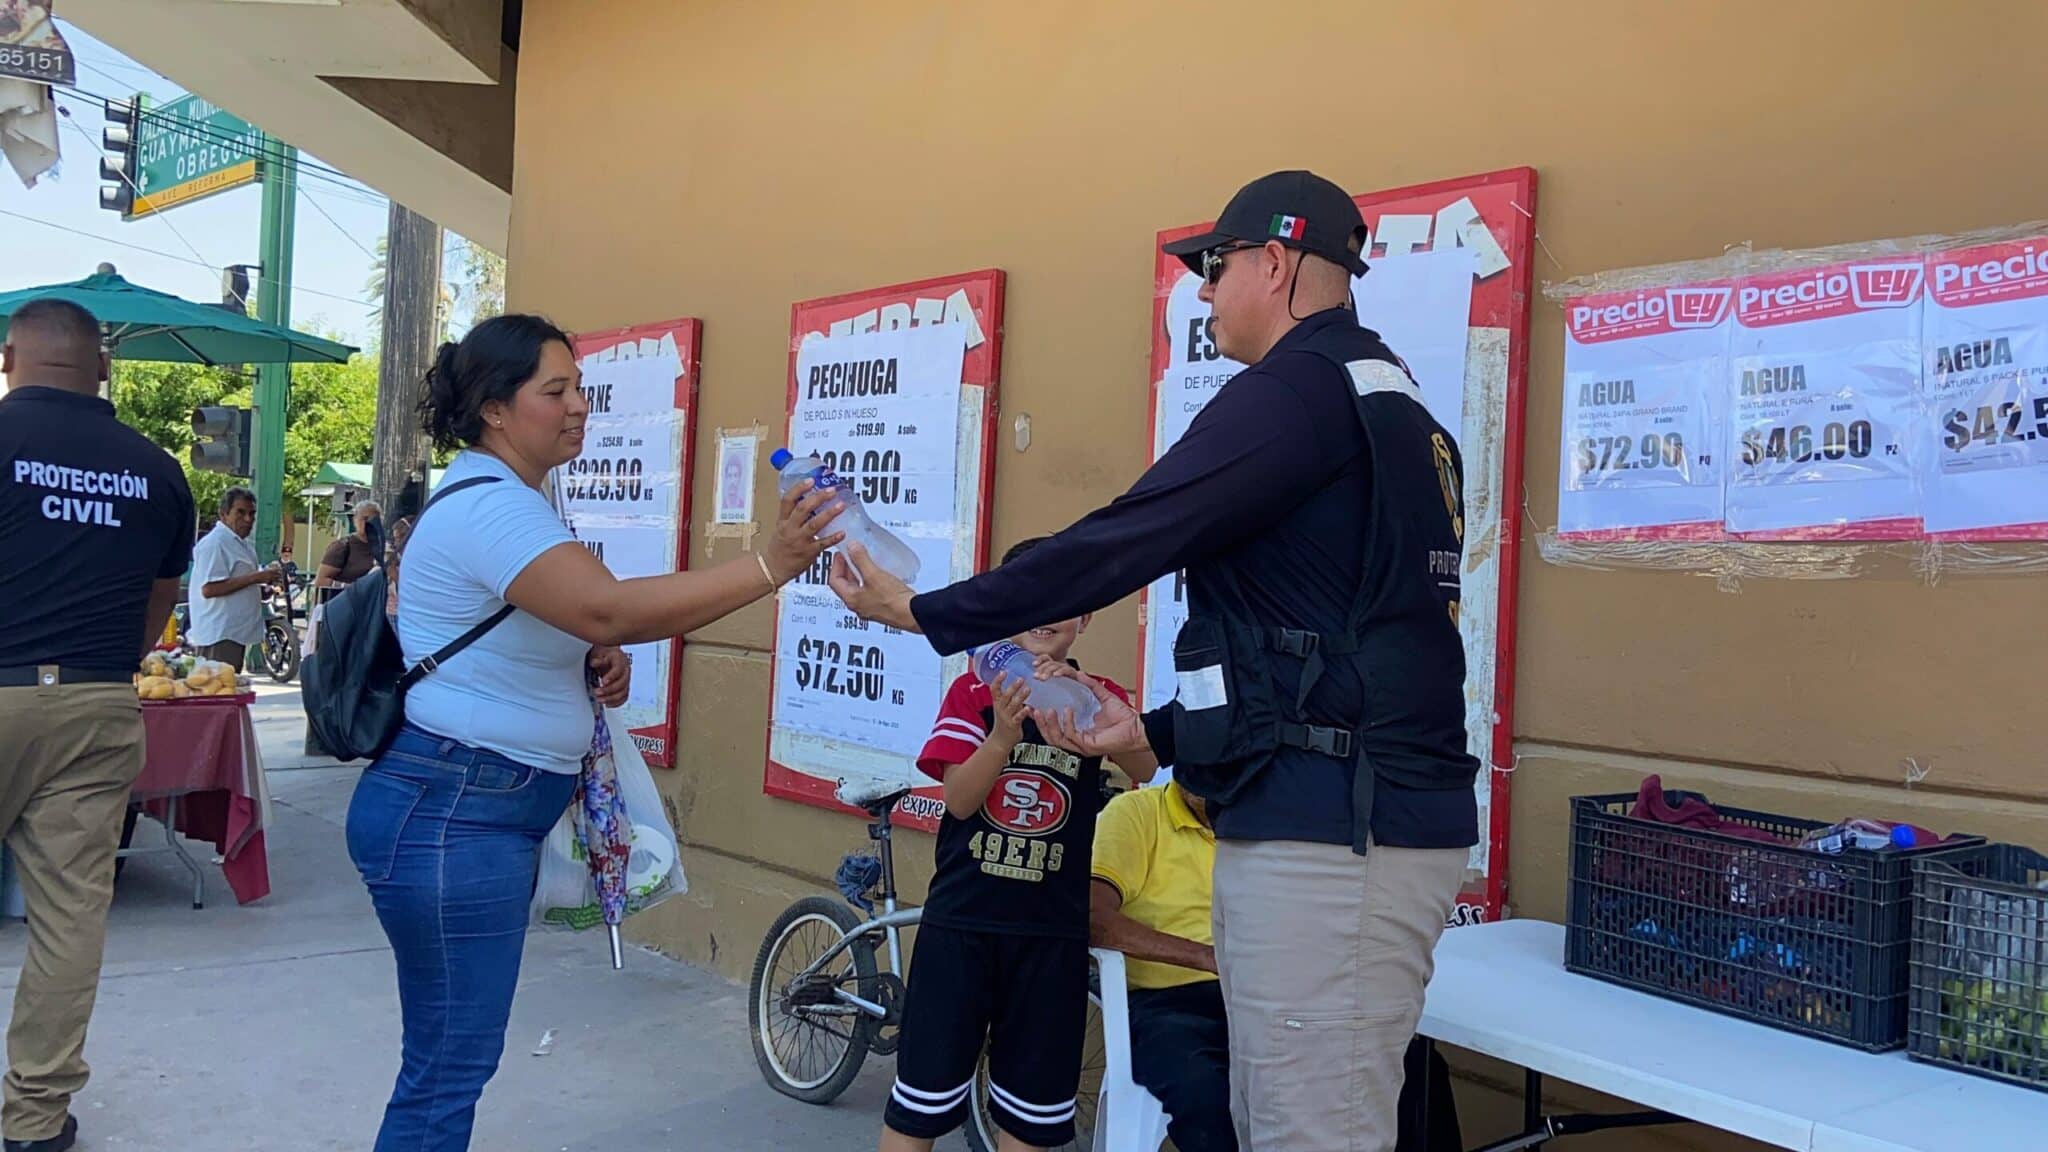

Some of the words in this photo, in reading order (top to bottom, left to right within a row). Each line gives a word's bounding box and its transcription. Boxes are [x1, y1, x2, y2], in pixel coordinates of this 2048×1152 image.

[0, 47, 63, 72] 65151
[140, 120, 210, 167] GUAYMAS
[188, 172, 226, 192] REFORMA
[1740, 272, 1848, 314] Precio
[1573, 294, 1665, 331] Precio
[1187, 316, 1221, 362] ES
[1936, 336, 2014, 375] AGUA
[807, 358, 899, 400] PECHUGA
[1184, 376, 1200, 389] DE
[1578, 379, 1635, 407] AGUA
[1740, 365, 1807, 397] AGUA
[803, 411, 814, 421] DE
[815, 409, 836, 421] POLLO
[852, 407, 878, 419] HUESO
[1661, 405, 1688, 415] BRAND
[1740, 400, 1778, 410] NATURAL
[856, 422, 885, 437] $119.90
[1741, 420, 1872, 468] $46.00
[1885, 444, 1899, 455] PZ
[1578, 432, 1683, 474] $72.90
[1699, 455, 1711, 466] PQ
[14, 459, 148, 500] PROTECCIÓN
[566, 458, 643, 503] $229.90
[904, 488, 917, 504] KG
[41, 494, 122, 527] CIVIL
[843, 615, 869, 632] $84.90
[796, 633, 884, 702] $72.50
[891, 689, 904, 705] KG
[1013, 742, 1081, 780] FRANCISC
[902, 795, 944, 818] expre
[1002, 779, 1055, 827] SF
[968, 831, 1064, 871] 49ERS
